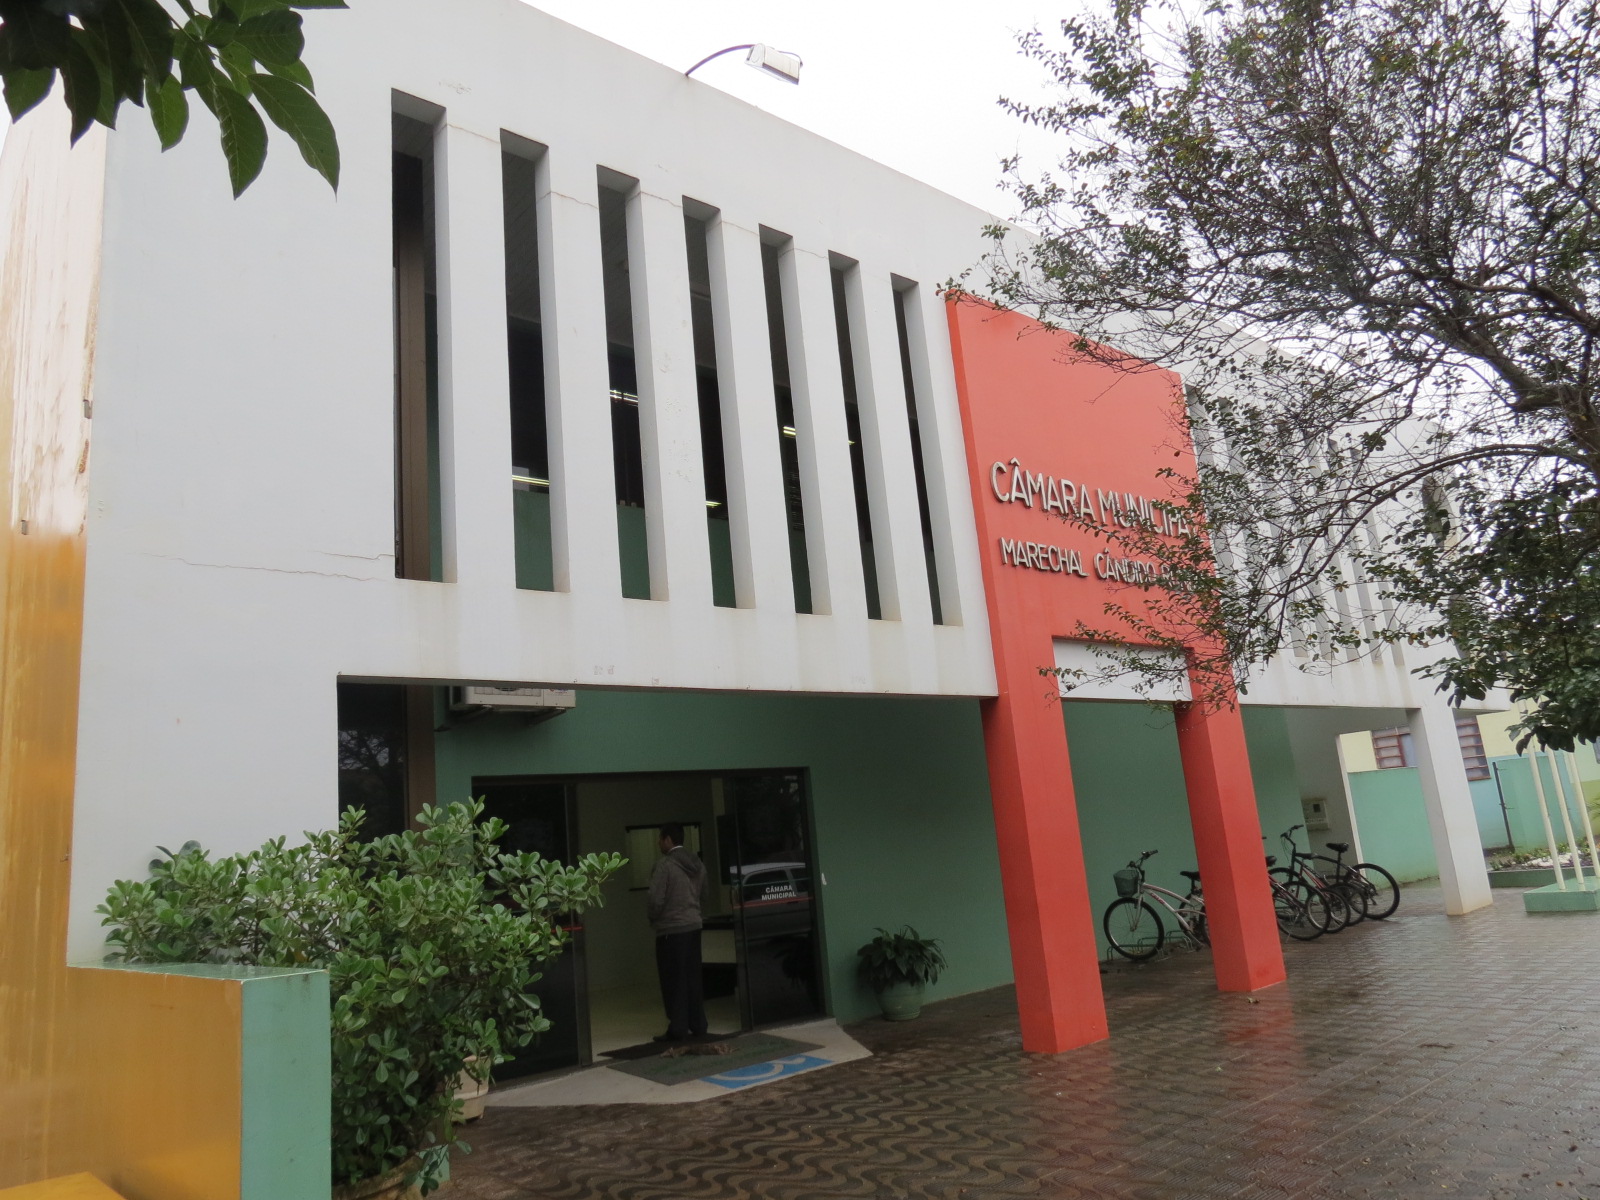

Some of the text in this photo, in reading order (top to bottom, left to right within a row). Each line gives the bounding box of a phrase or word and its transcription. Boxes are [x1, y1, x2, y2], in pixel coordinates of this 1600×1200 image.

[990, 457, 1199, 539] CÂMARA MUNICIPA
[1001, 537, 1089, 578] MARECHAL
[761, 891, 796, 900] MUNICIPAL
[765, 885, 793, 893] CÂMARA
